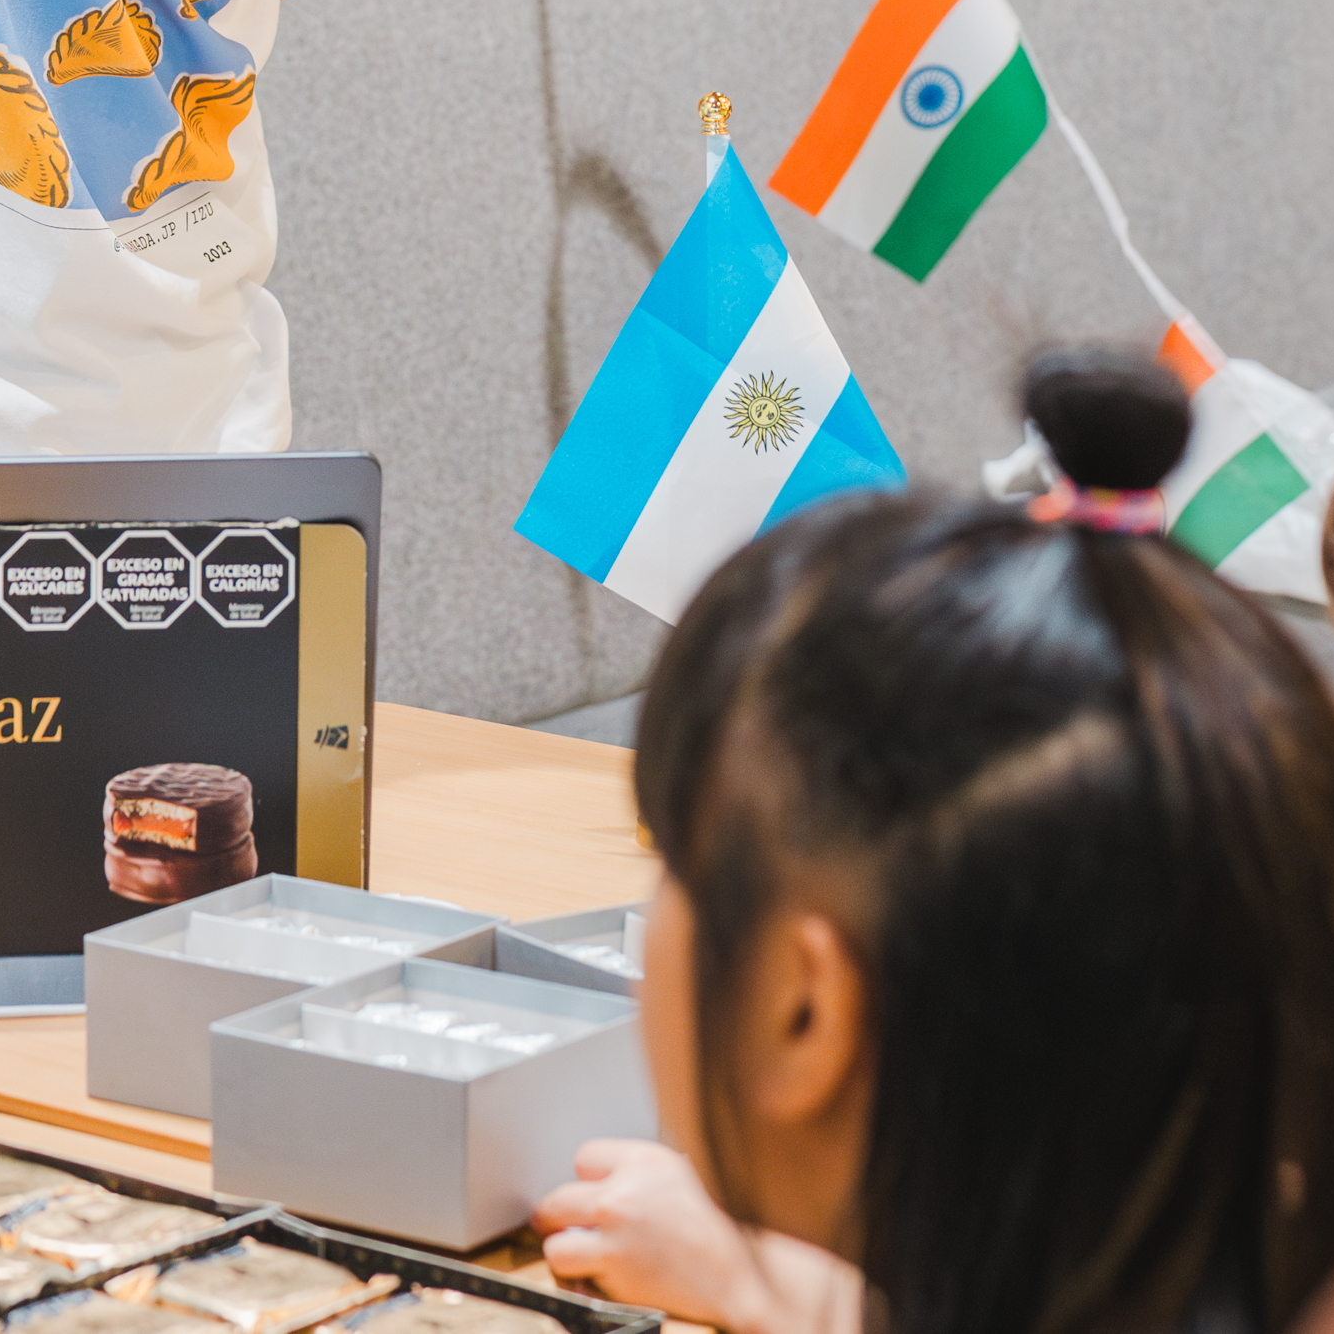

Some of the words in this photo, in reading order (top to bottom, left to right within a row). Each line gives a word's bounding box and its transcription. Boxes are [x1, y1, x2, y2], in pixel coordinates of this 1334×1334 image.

[203, 240, 232, 263] 2023
[106, 558, 162, 572] EXCESO
[163, 557, 185, 571] EN
[205, 564, 261, 578] EXCESO
[262, 564, 284, 577] EN
[7, 566, 63, 582] EXCESO
[64, 566, 86, 581] EN
[117, 572, 175, 587] GRASAS
[208, 576, 280, 592] CALORÍAS
[101, 587, 189, 602] SATURADAS
